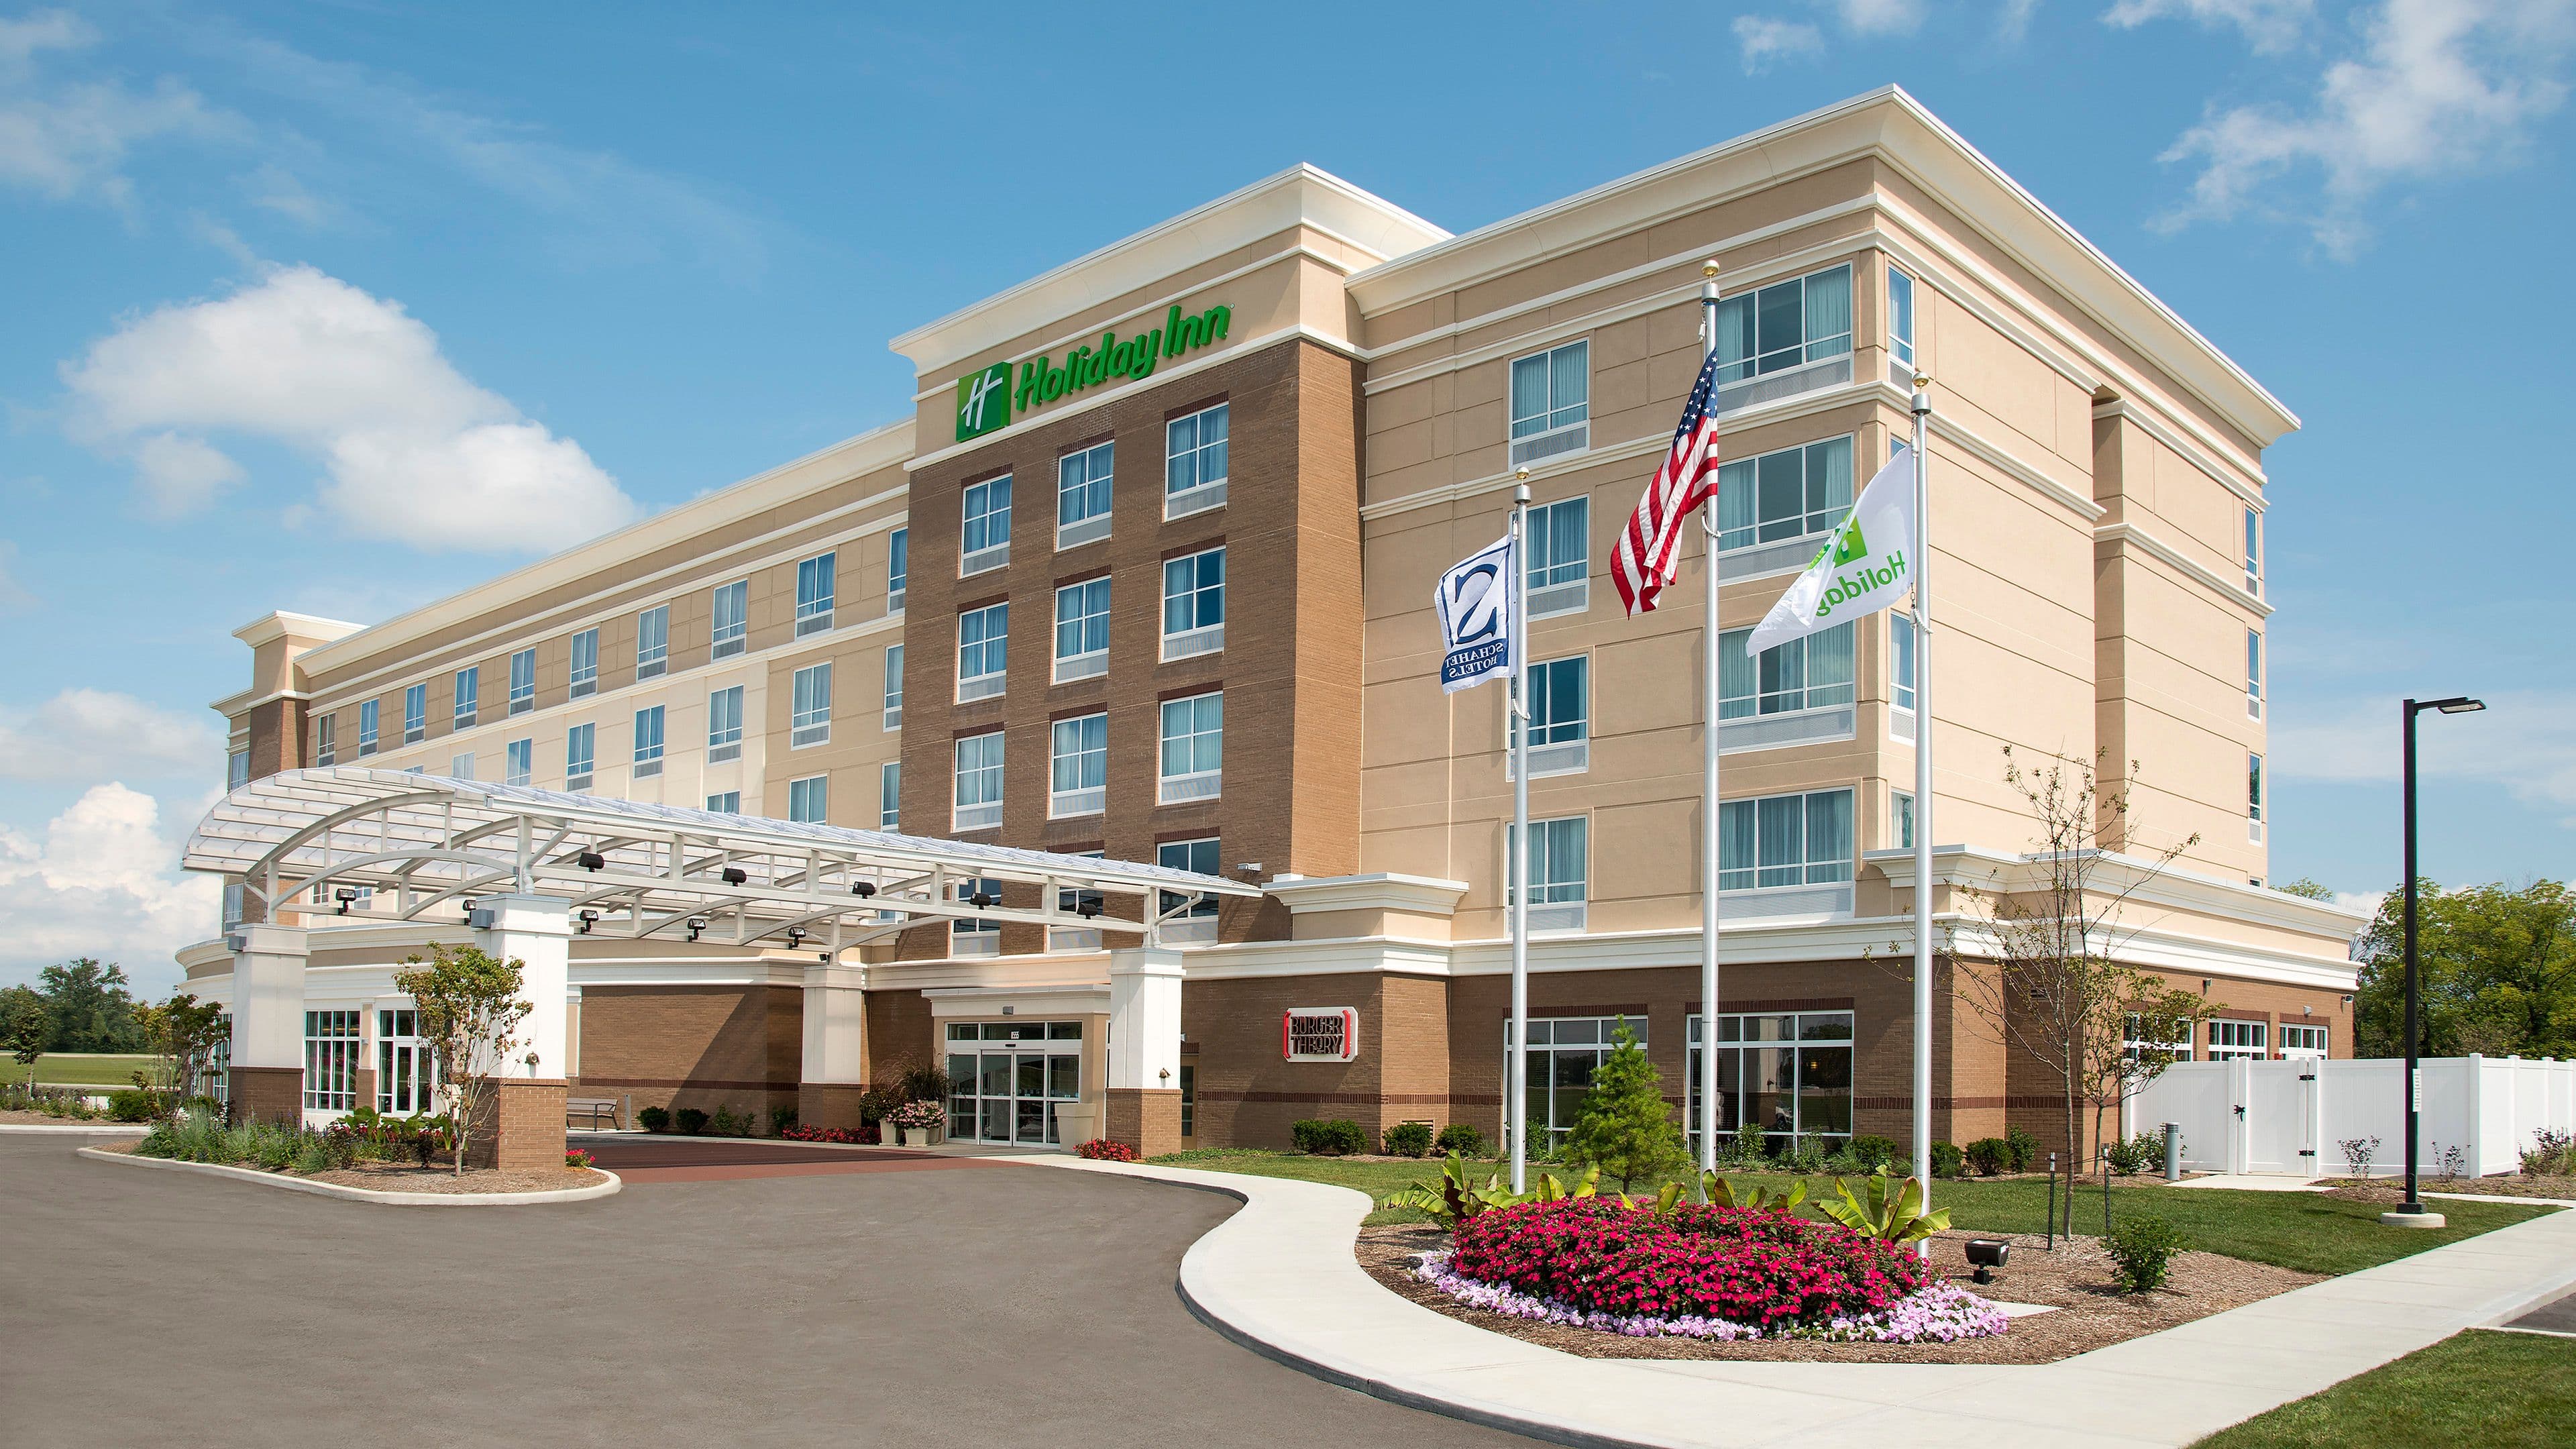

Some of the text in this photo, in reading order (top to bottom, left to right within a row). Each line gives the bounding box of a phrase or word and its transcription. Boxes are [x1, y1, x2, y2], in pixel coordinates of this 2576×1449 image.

[1014, 305, 1231, 412] Holiday Inn
[1291, 1015, 1343, 1034] BURGER
[1291, 1036, 1343, 1054] THEORY
